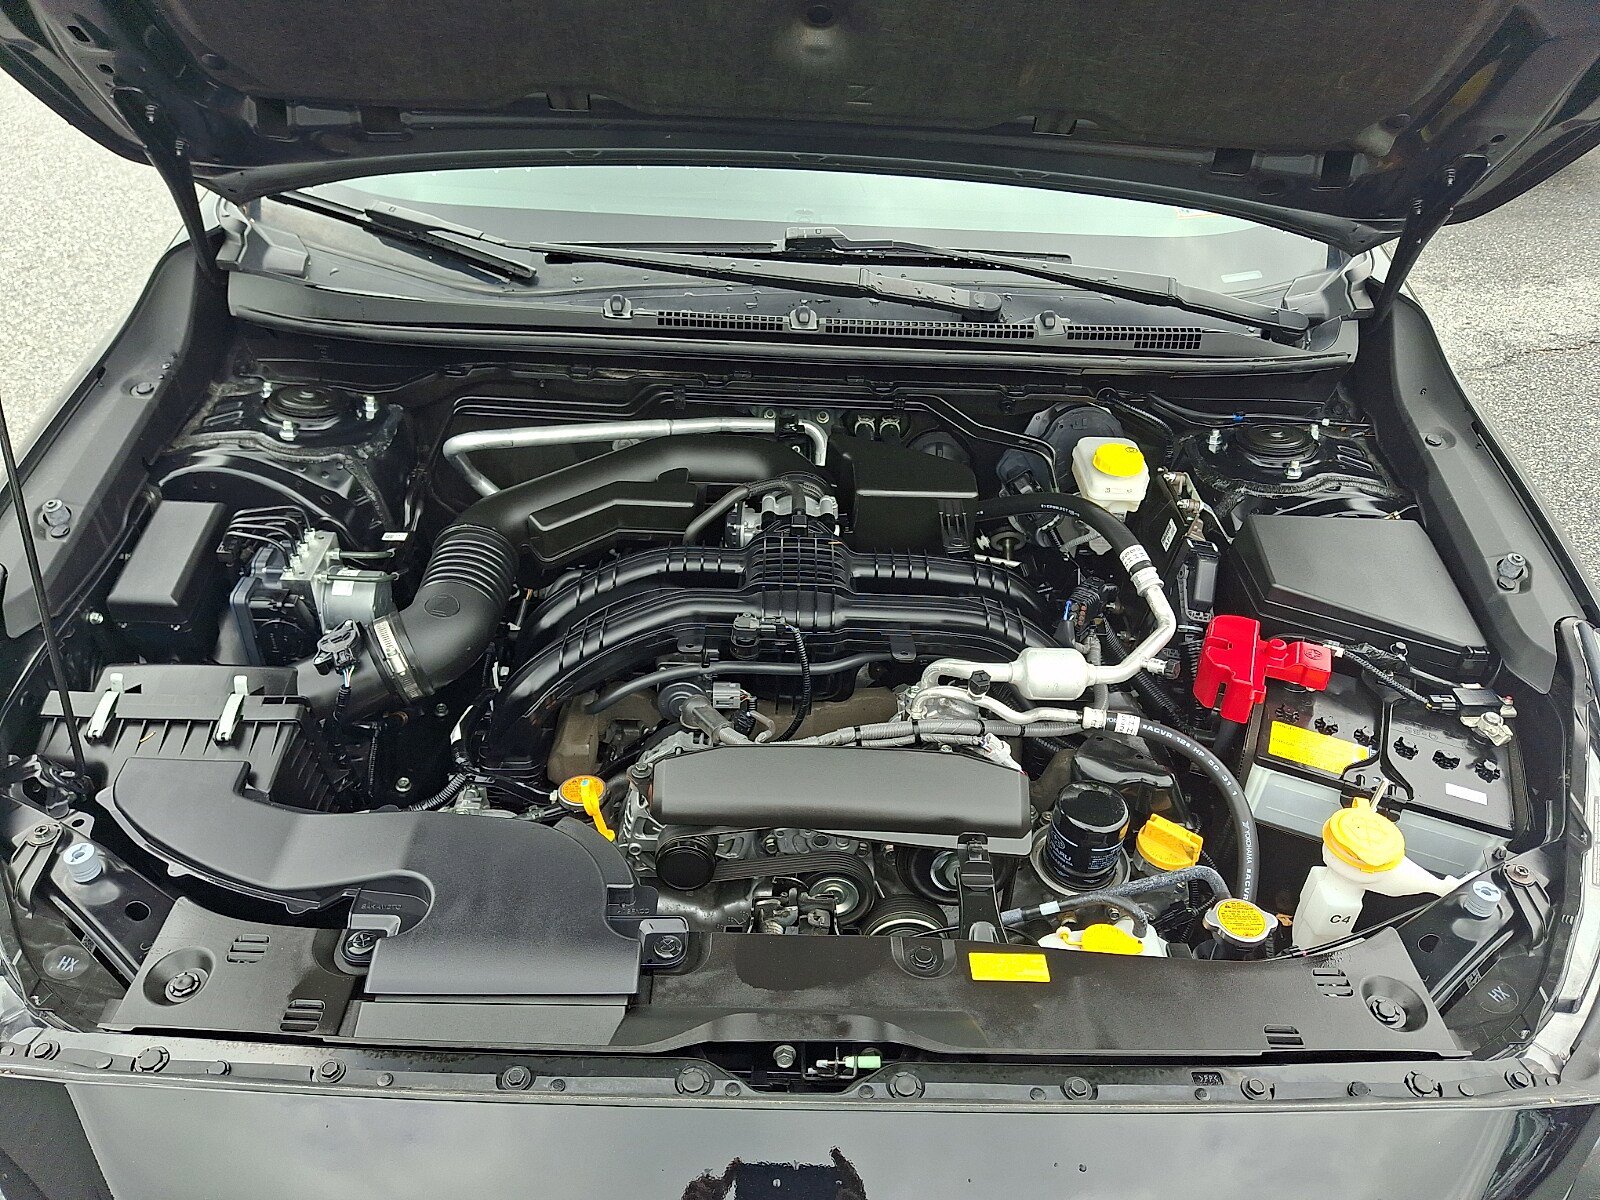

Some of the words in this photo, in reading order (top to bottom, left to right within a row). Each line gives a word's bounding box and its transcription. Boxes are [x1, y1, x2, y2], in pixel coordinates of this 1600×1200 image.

[1244, 827, 1253, 864] YOKOHAMA
[1329, 914, 1351, 924] C4
[56, 955, 80, 973] HX
[1487, 985, 1511, 1003] HX
